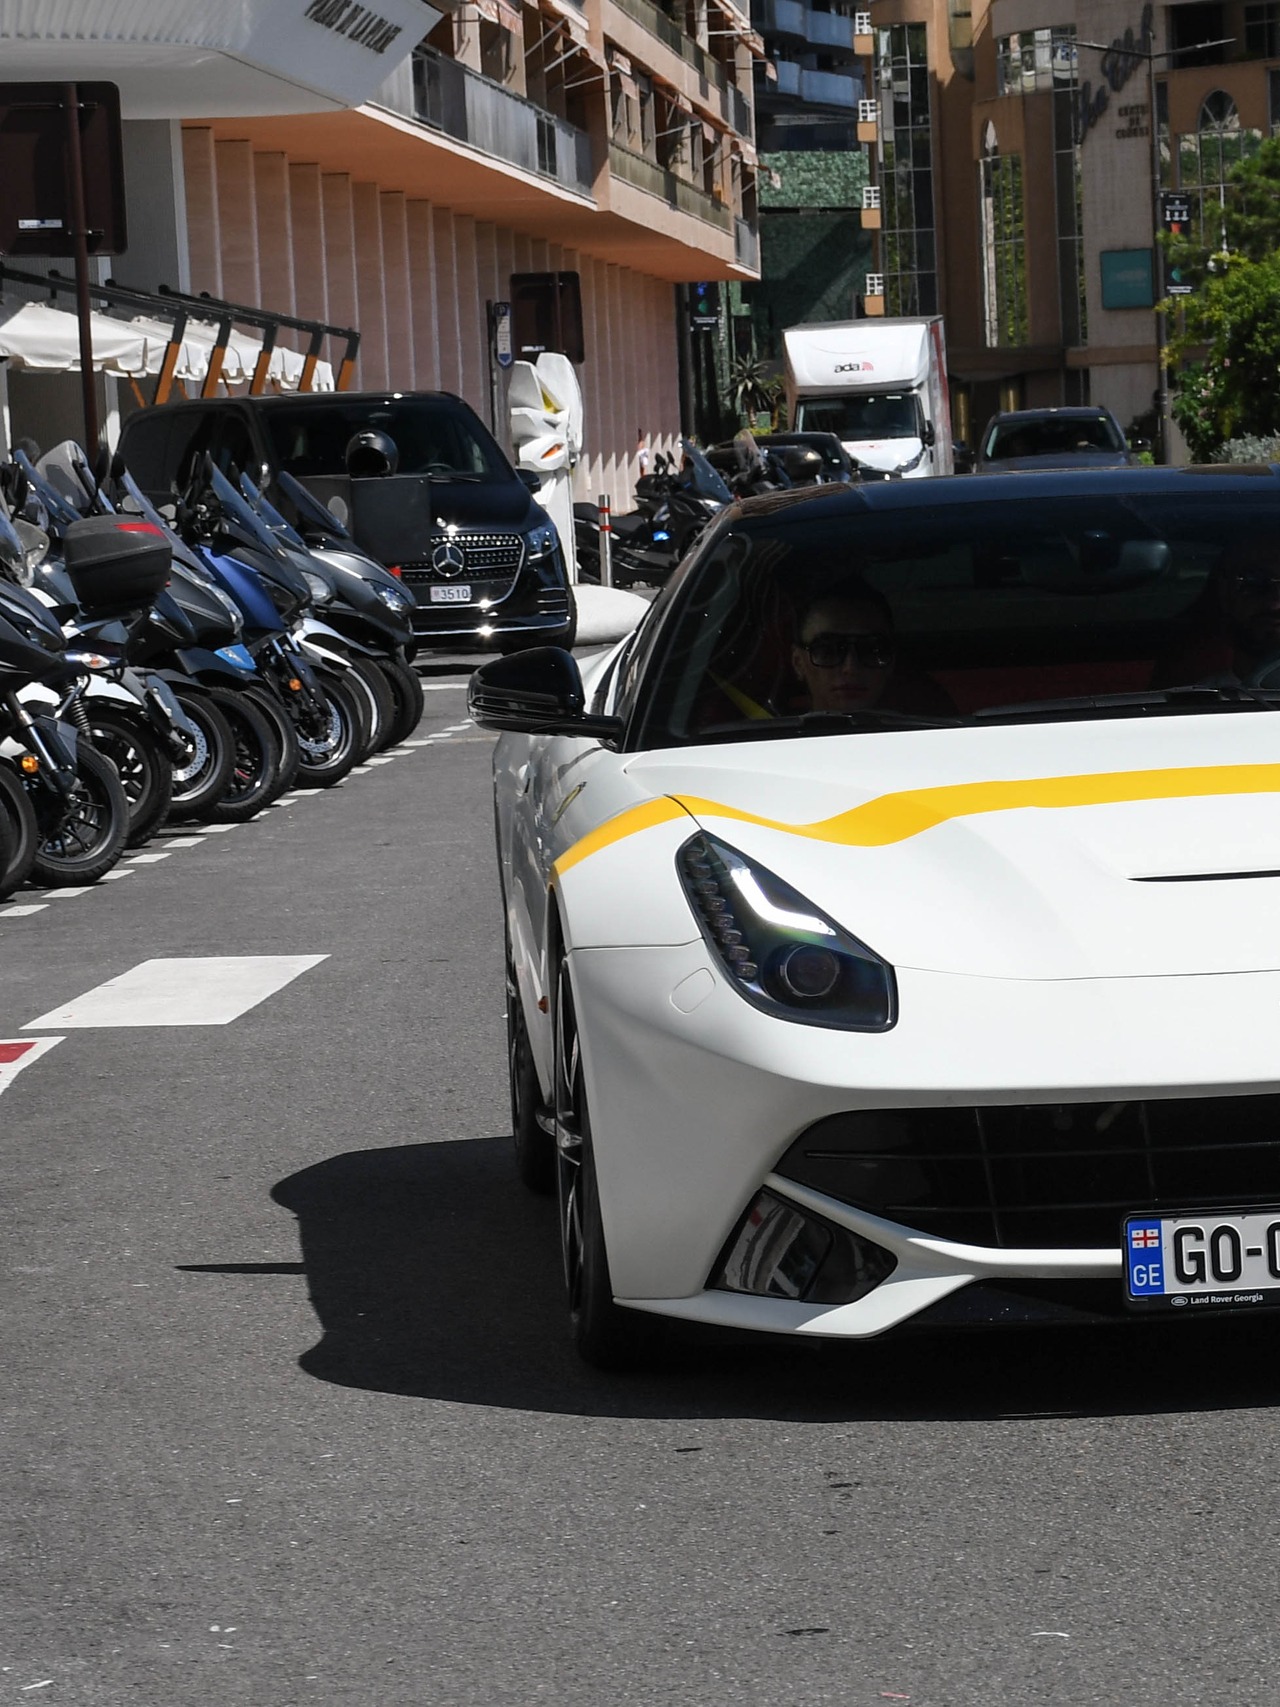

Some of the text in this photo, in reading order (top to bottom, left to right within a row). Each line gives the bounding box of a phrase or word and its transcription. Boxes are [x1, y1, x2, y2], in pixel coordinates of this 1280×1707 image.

[834, 363, 860, 373] ada
[441, 589, 469, 600] 3510
[1133, 1264, 1161, 1286] GE
[1190, 1296, 1209, 1305] Land
[1210, 1295, 1233, 1303] Rover
[1234, 1292, 1264, 1303] Georgia
